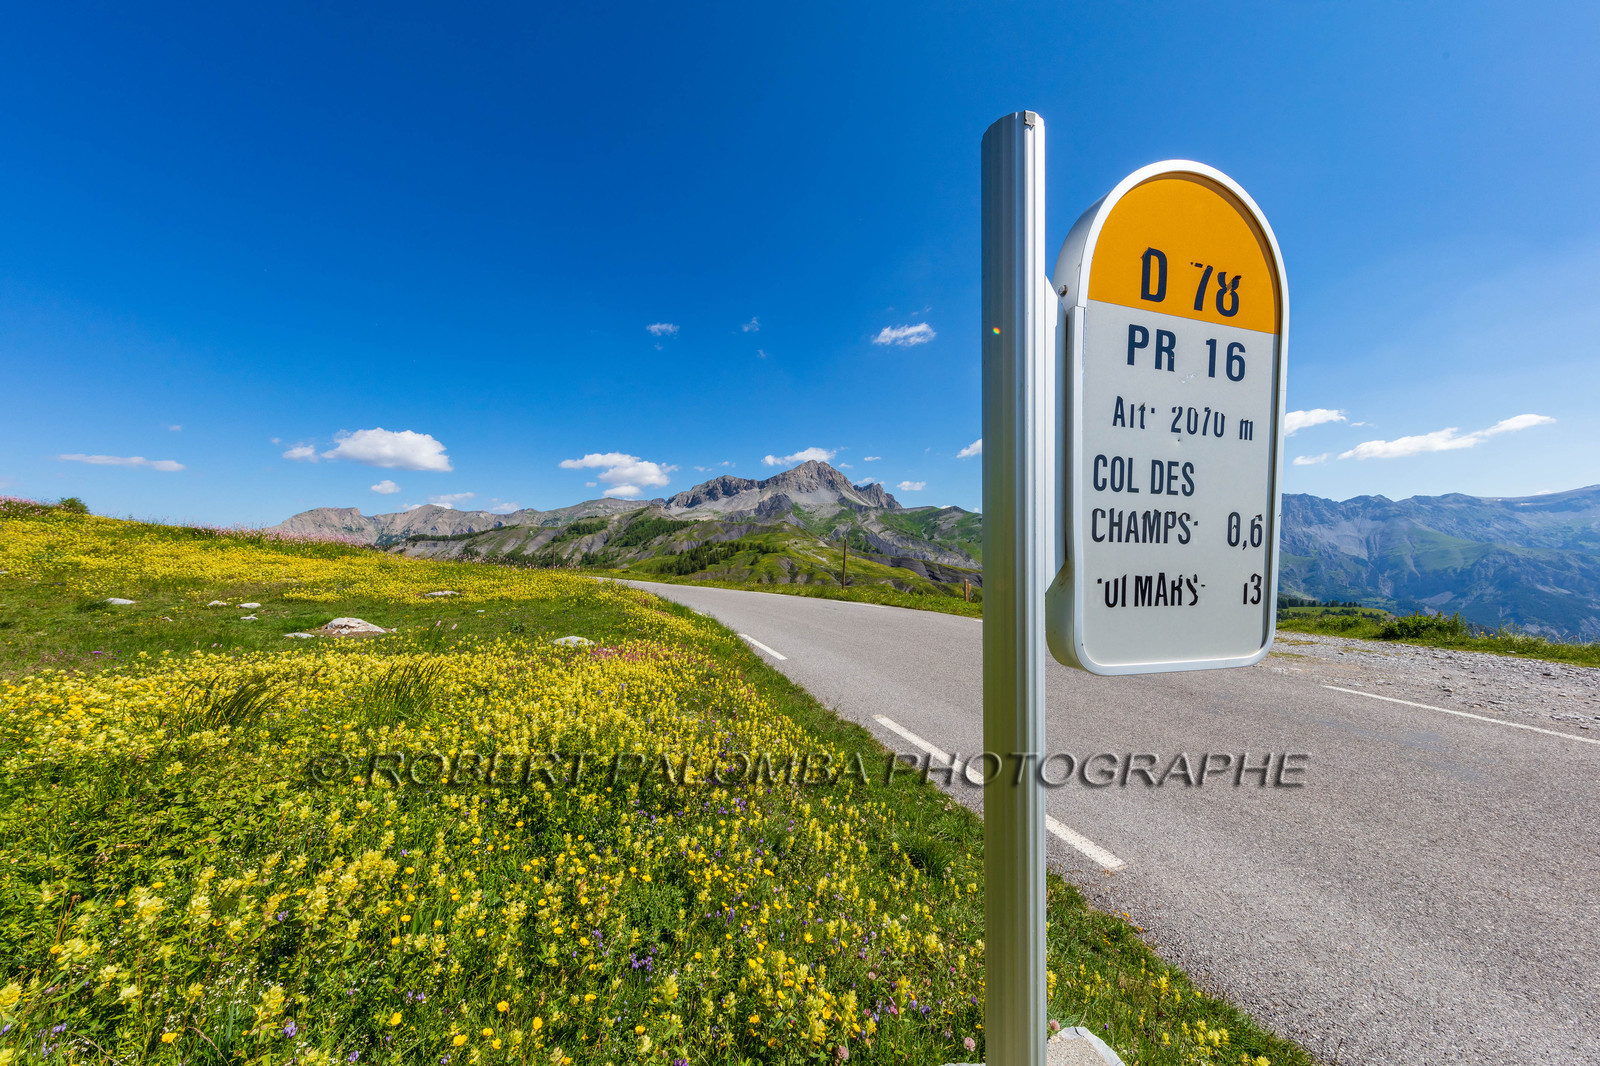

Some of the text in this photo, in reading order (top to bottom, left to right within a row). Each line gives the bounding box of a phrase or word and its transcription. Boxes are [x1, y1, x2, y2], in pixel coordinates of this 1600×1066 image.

[1140, 247, 1242, 317] D 78
[1127, 323, 1246, 382] PR 16
[1170, 406, 1226, 438] 2070
[1239, 418, 1254, 441] m
[1092, 453, 1195, 497] COL DES
[1226, 511, 1263, 550] 0,6
